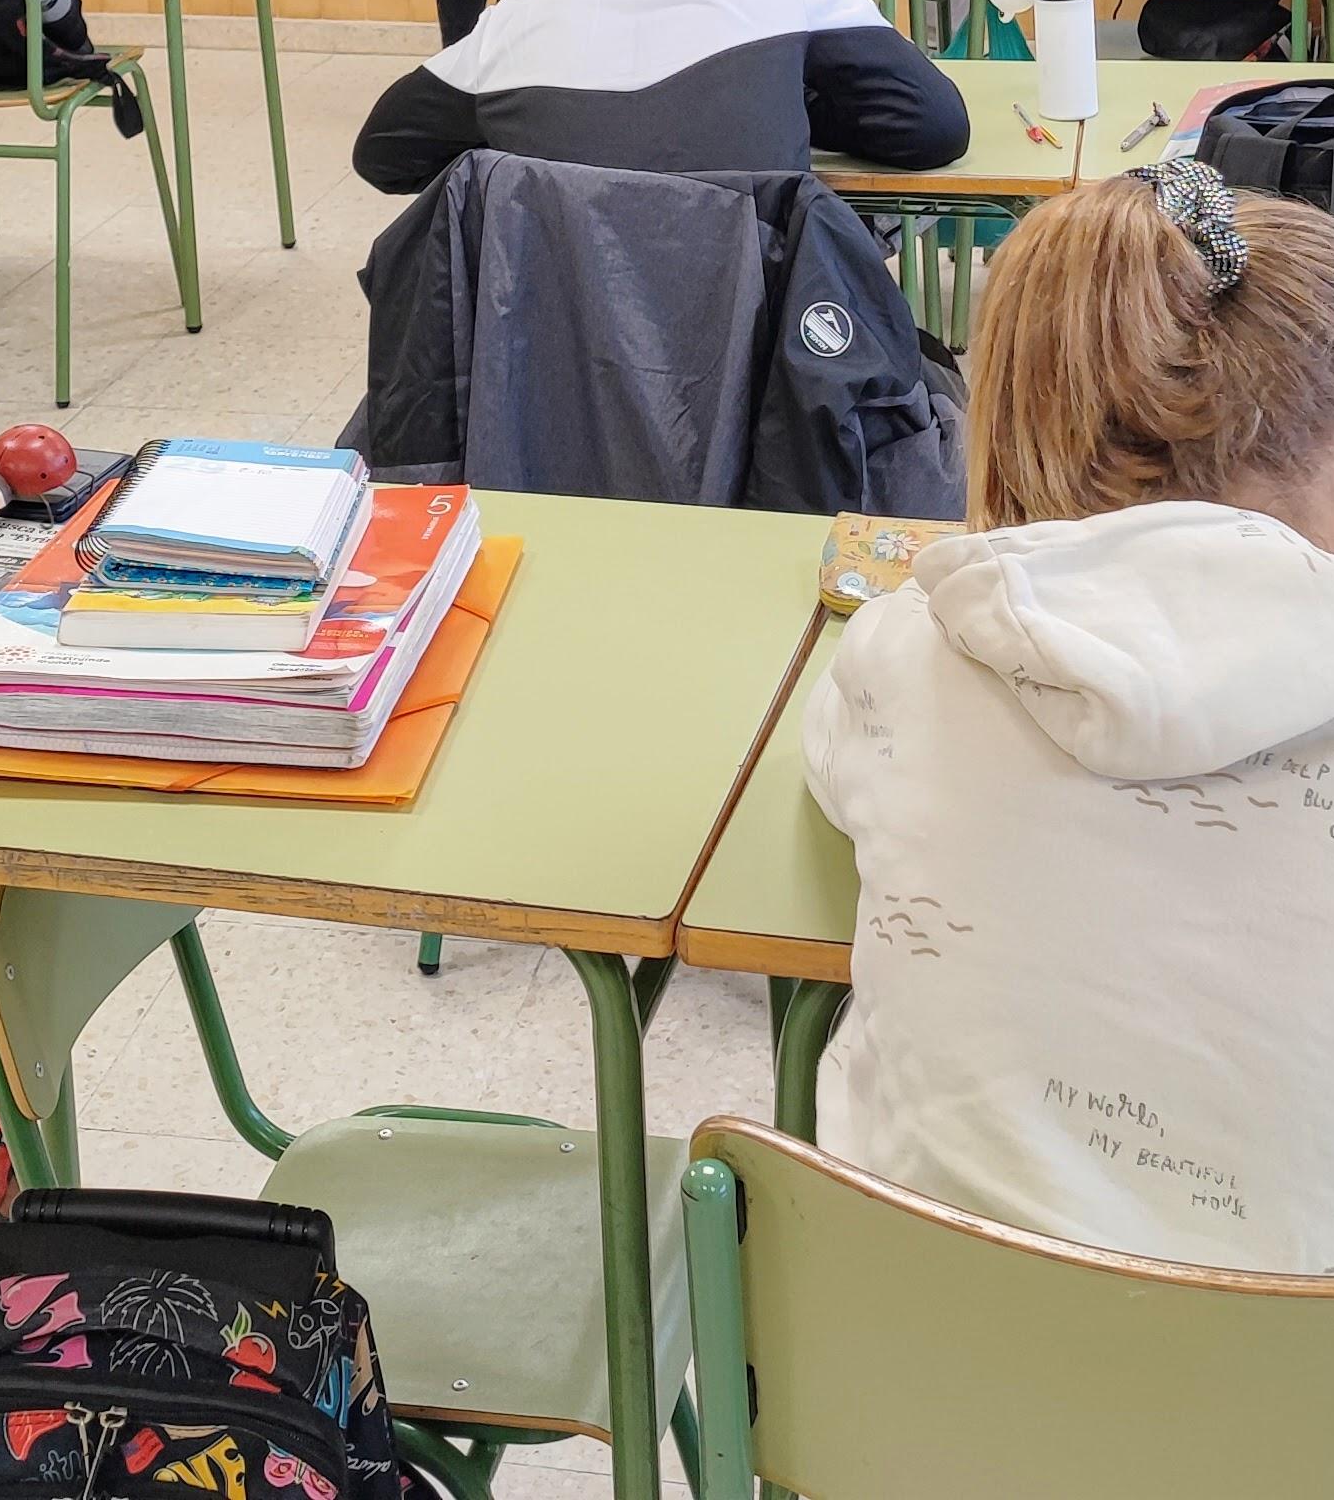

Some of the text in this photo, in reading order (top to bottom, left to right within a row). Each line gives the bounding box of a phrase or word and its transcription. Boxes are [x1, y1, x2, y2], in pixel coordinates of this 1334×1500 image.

[427, 494, 454, 515] 5
[1281, 758, 1331, 781] DEEP
[1044, 1078, 1078, 1108] MY
[1088, 1128, 1237, 1190] MY BEAUTIFUL
[1191, 1189, 1247, 1220] HOUSE
